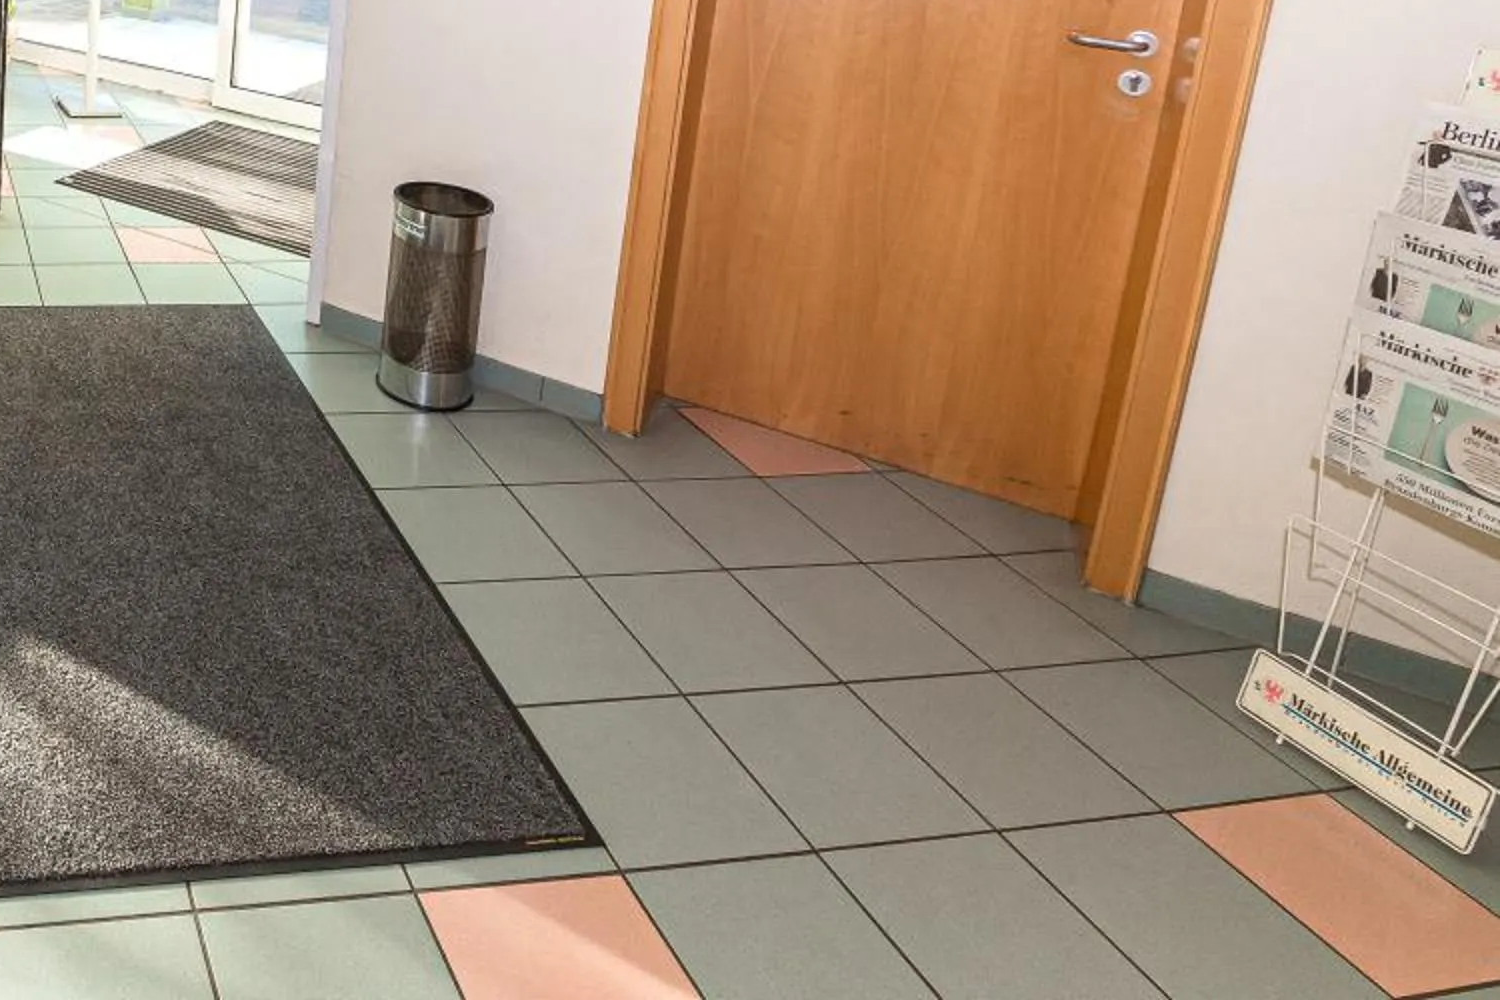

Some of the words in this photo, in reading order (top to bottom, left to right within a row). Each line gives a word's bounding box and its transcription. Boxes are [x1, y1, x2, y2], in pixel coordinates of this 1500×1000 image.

[1400, 233, 1499, 278] Märkische
[1378, 331, 1473, 378] Märkische
[1288, 692, 1372, 755] Märkische
[1376, 749, 1473, 819] Allgemeine
